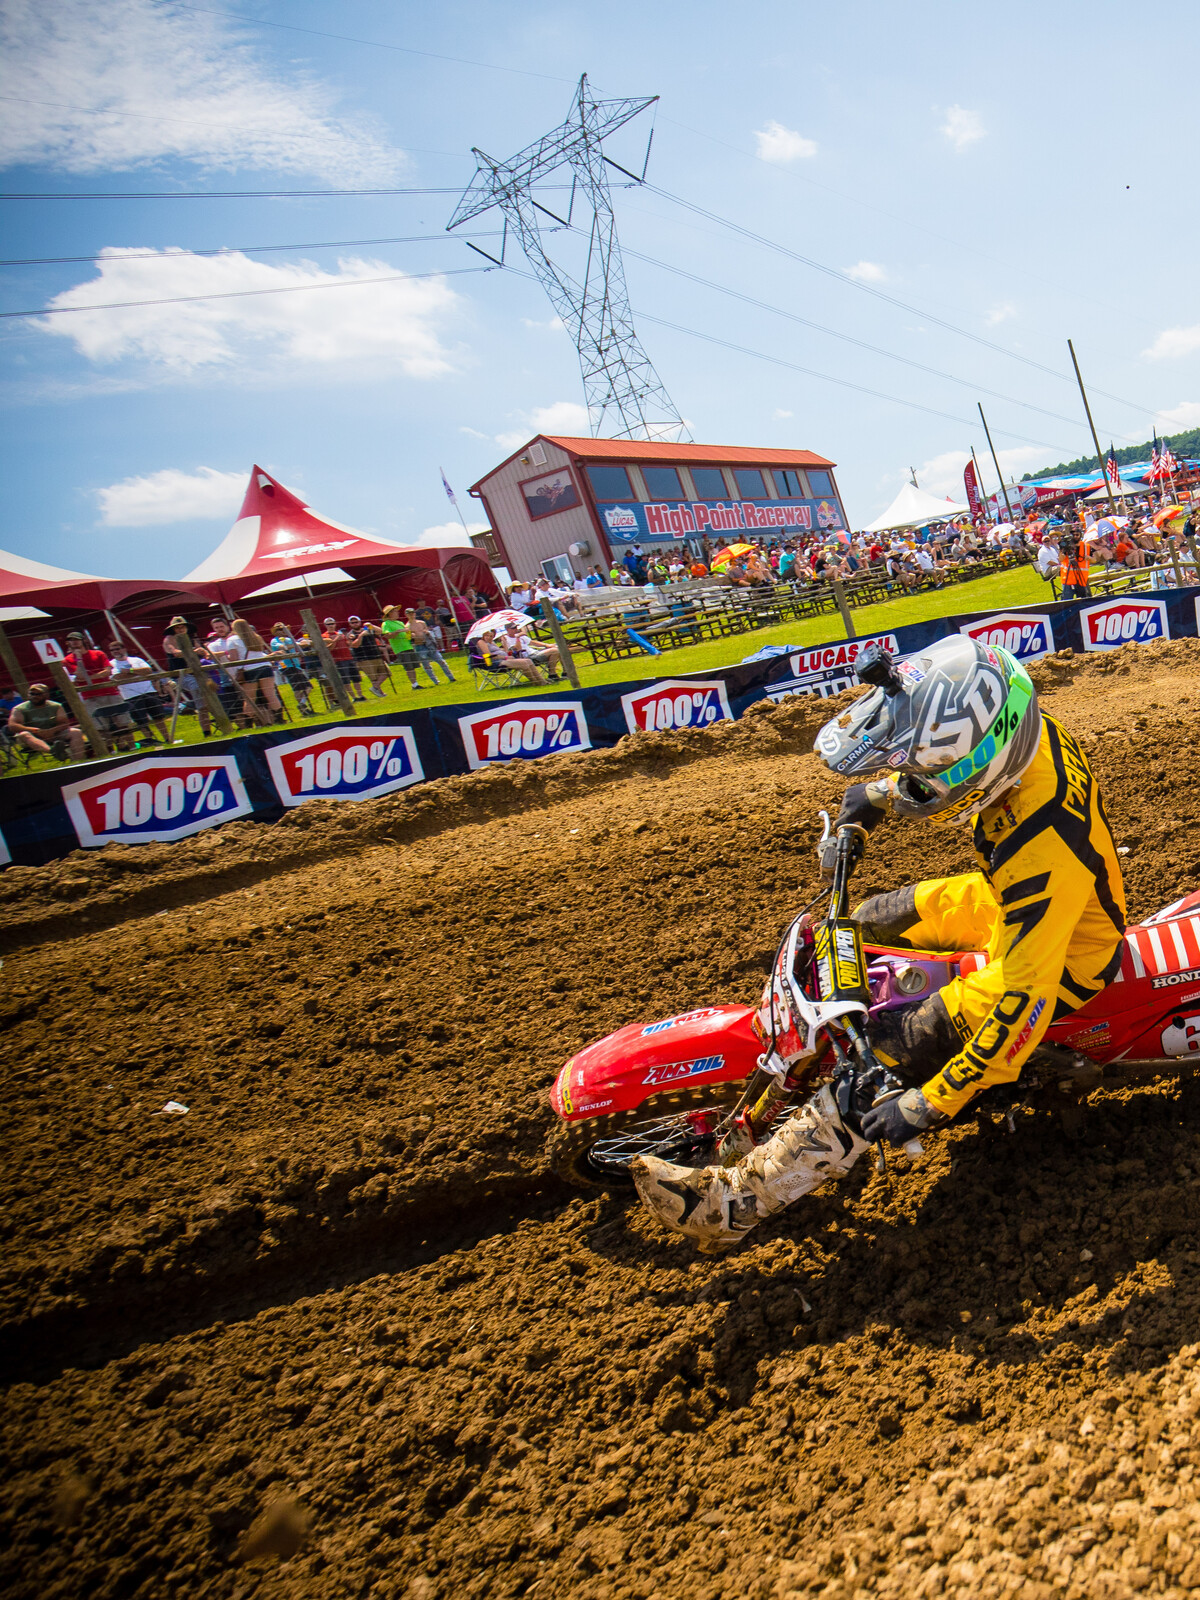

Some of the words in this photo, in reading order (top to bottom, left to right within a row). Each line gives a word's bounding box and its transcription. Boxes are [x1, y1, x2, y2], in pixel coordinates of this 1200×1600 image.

[1038, 492, 1055, 502] LUCAS
[612, 516, 635, 527] LUCAS
[644, 504, 696, 539] High
[692, 503, 745, 532] Point
[741, 502, 812, 529] Raceway
[1094, 608, 1157, 642] 100%
[45, 643, 58, 659] 4
[641, 690, 717, 731] 100%
[482, 712, 573, 758] 100%
[295, 738, 403, 792] 100%
[836, 738, 875, 771] GARMIN
[96, 769, 225, 831] 100%
[927, 789, 986, 823] GEICO
[838, 961, 860, 989] PRO
[1004, 997, 1047, 1066] AMSOIL
[642, 1054, 726, 1085] AMSOIL
[561, 1060, 575, 1116] GEICO
[579, 1099, 613, 1112] DUNLOP
